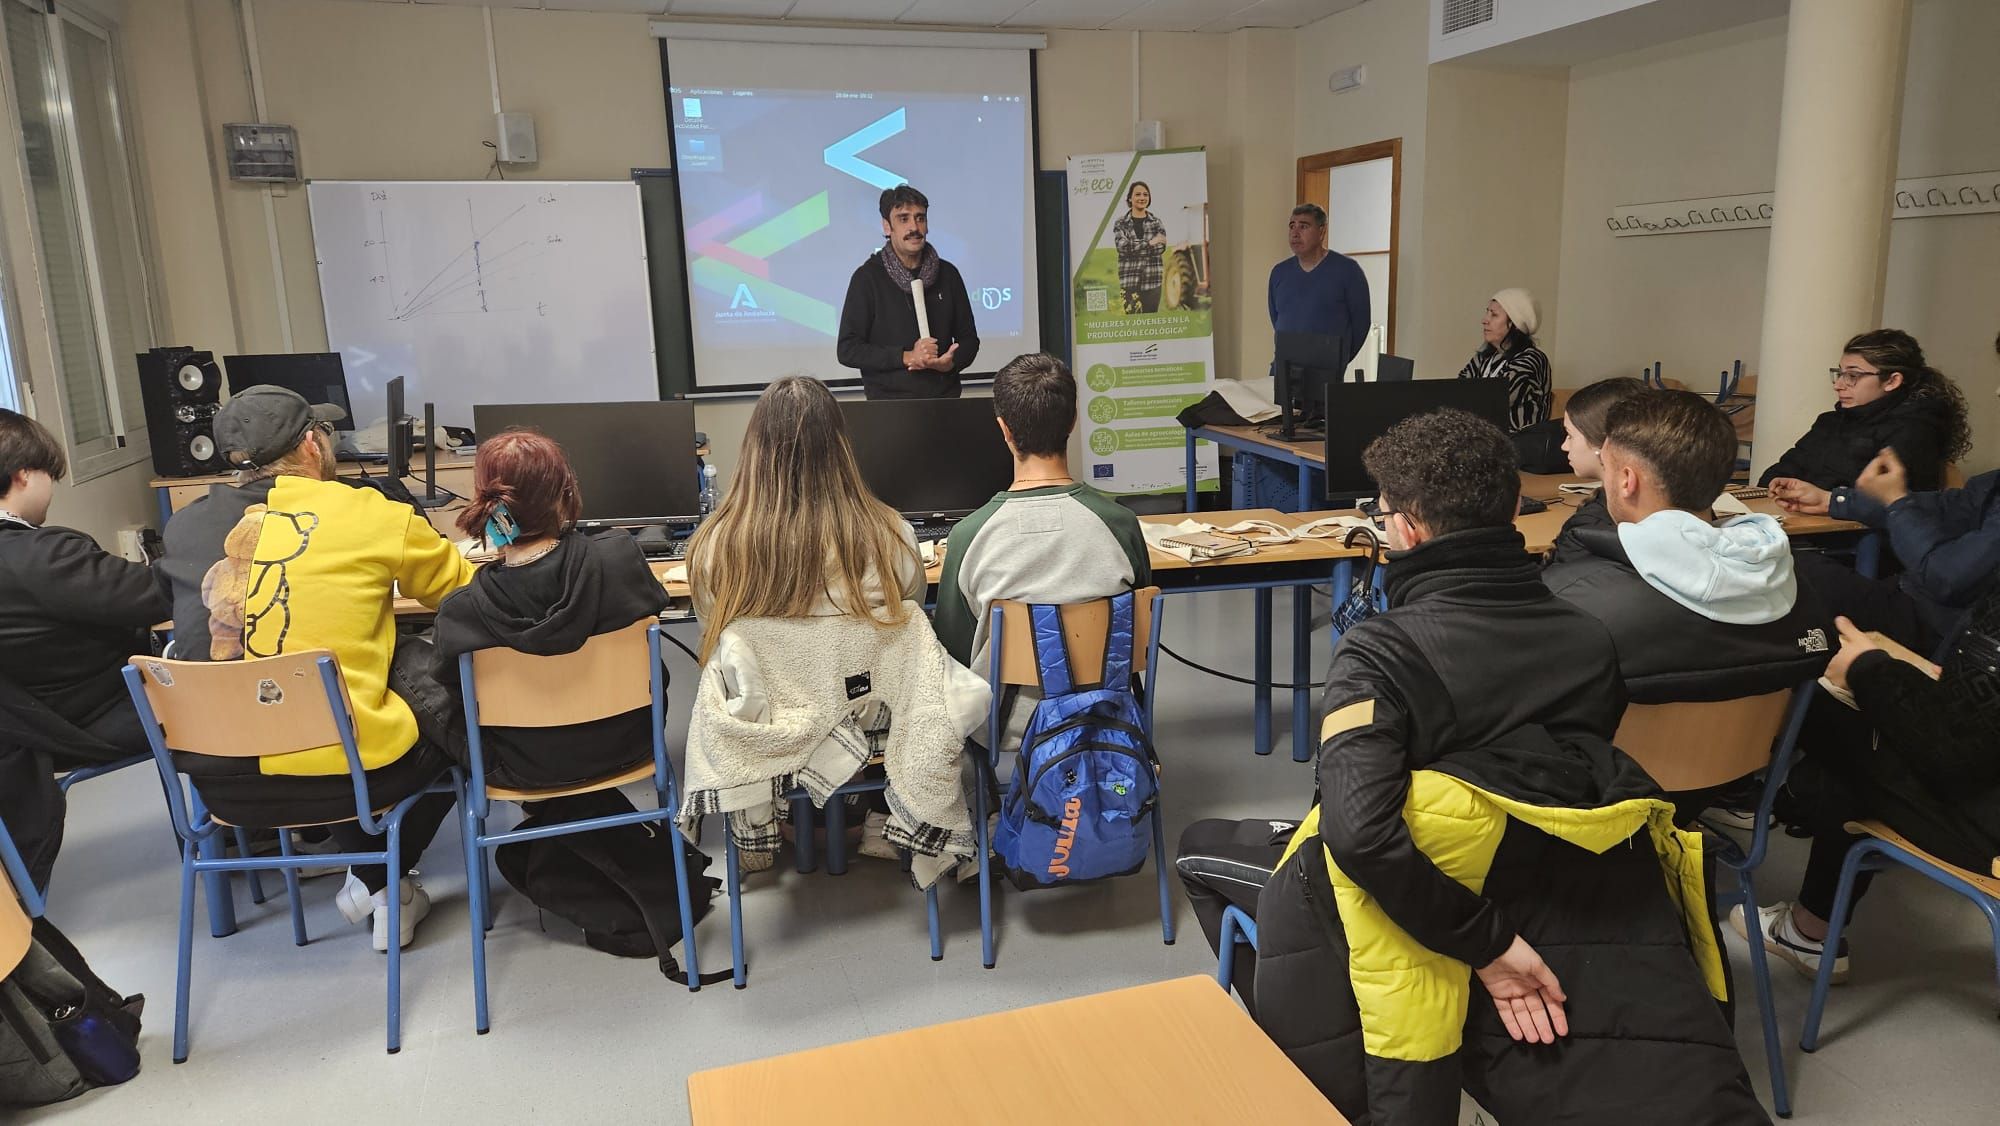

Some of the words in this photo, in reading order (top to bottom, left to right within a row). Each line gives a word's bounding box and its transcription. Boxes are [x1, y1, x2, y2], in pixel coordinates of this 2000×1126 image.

[1091, 178, 1114, 191] eco
[1087, 328, 1138, 339] PRODUCCIÓN
[1807, 629, 1820, 637] THE
[1798, 637, 1818, 647] NORTH
